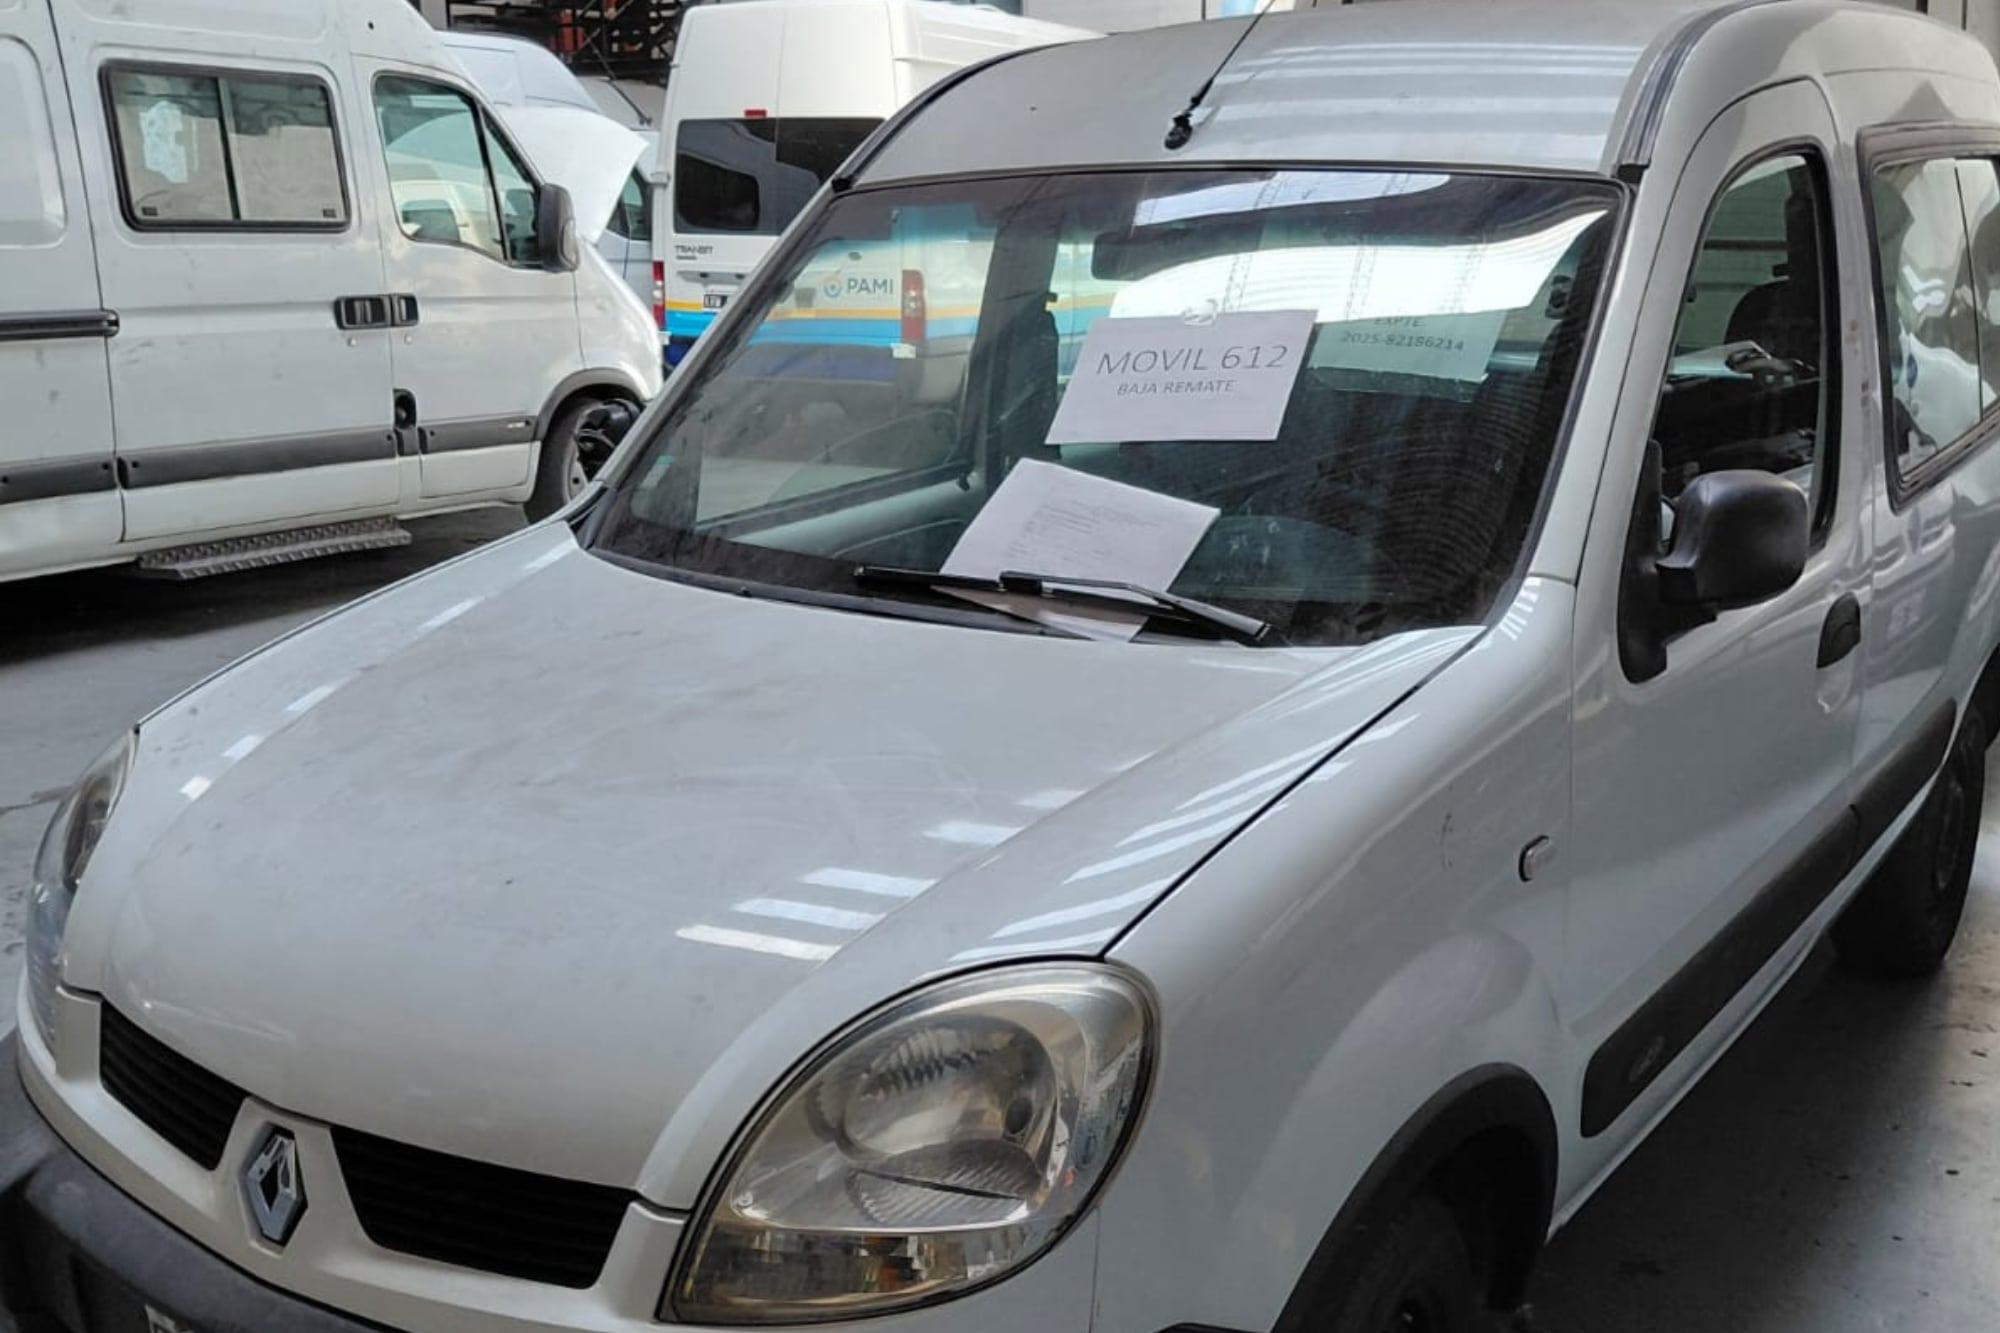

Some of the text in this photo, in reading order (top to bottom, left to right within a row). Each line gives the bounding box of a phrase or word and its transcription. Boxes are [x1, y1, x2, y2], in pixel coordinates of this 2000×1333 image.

[846, 278, 894, 295] PAMI
[1096, 344, 1289, 375] MOVIL 612
[1117, 379, 1237, 396] BAJA REMATE
